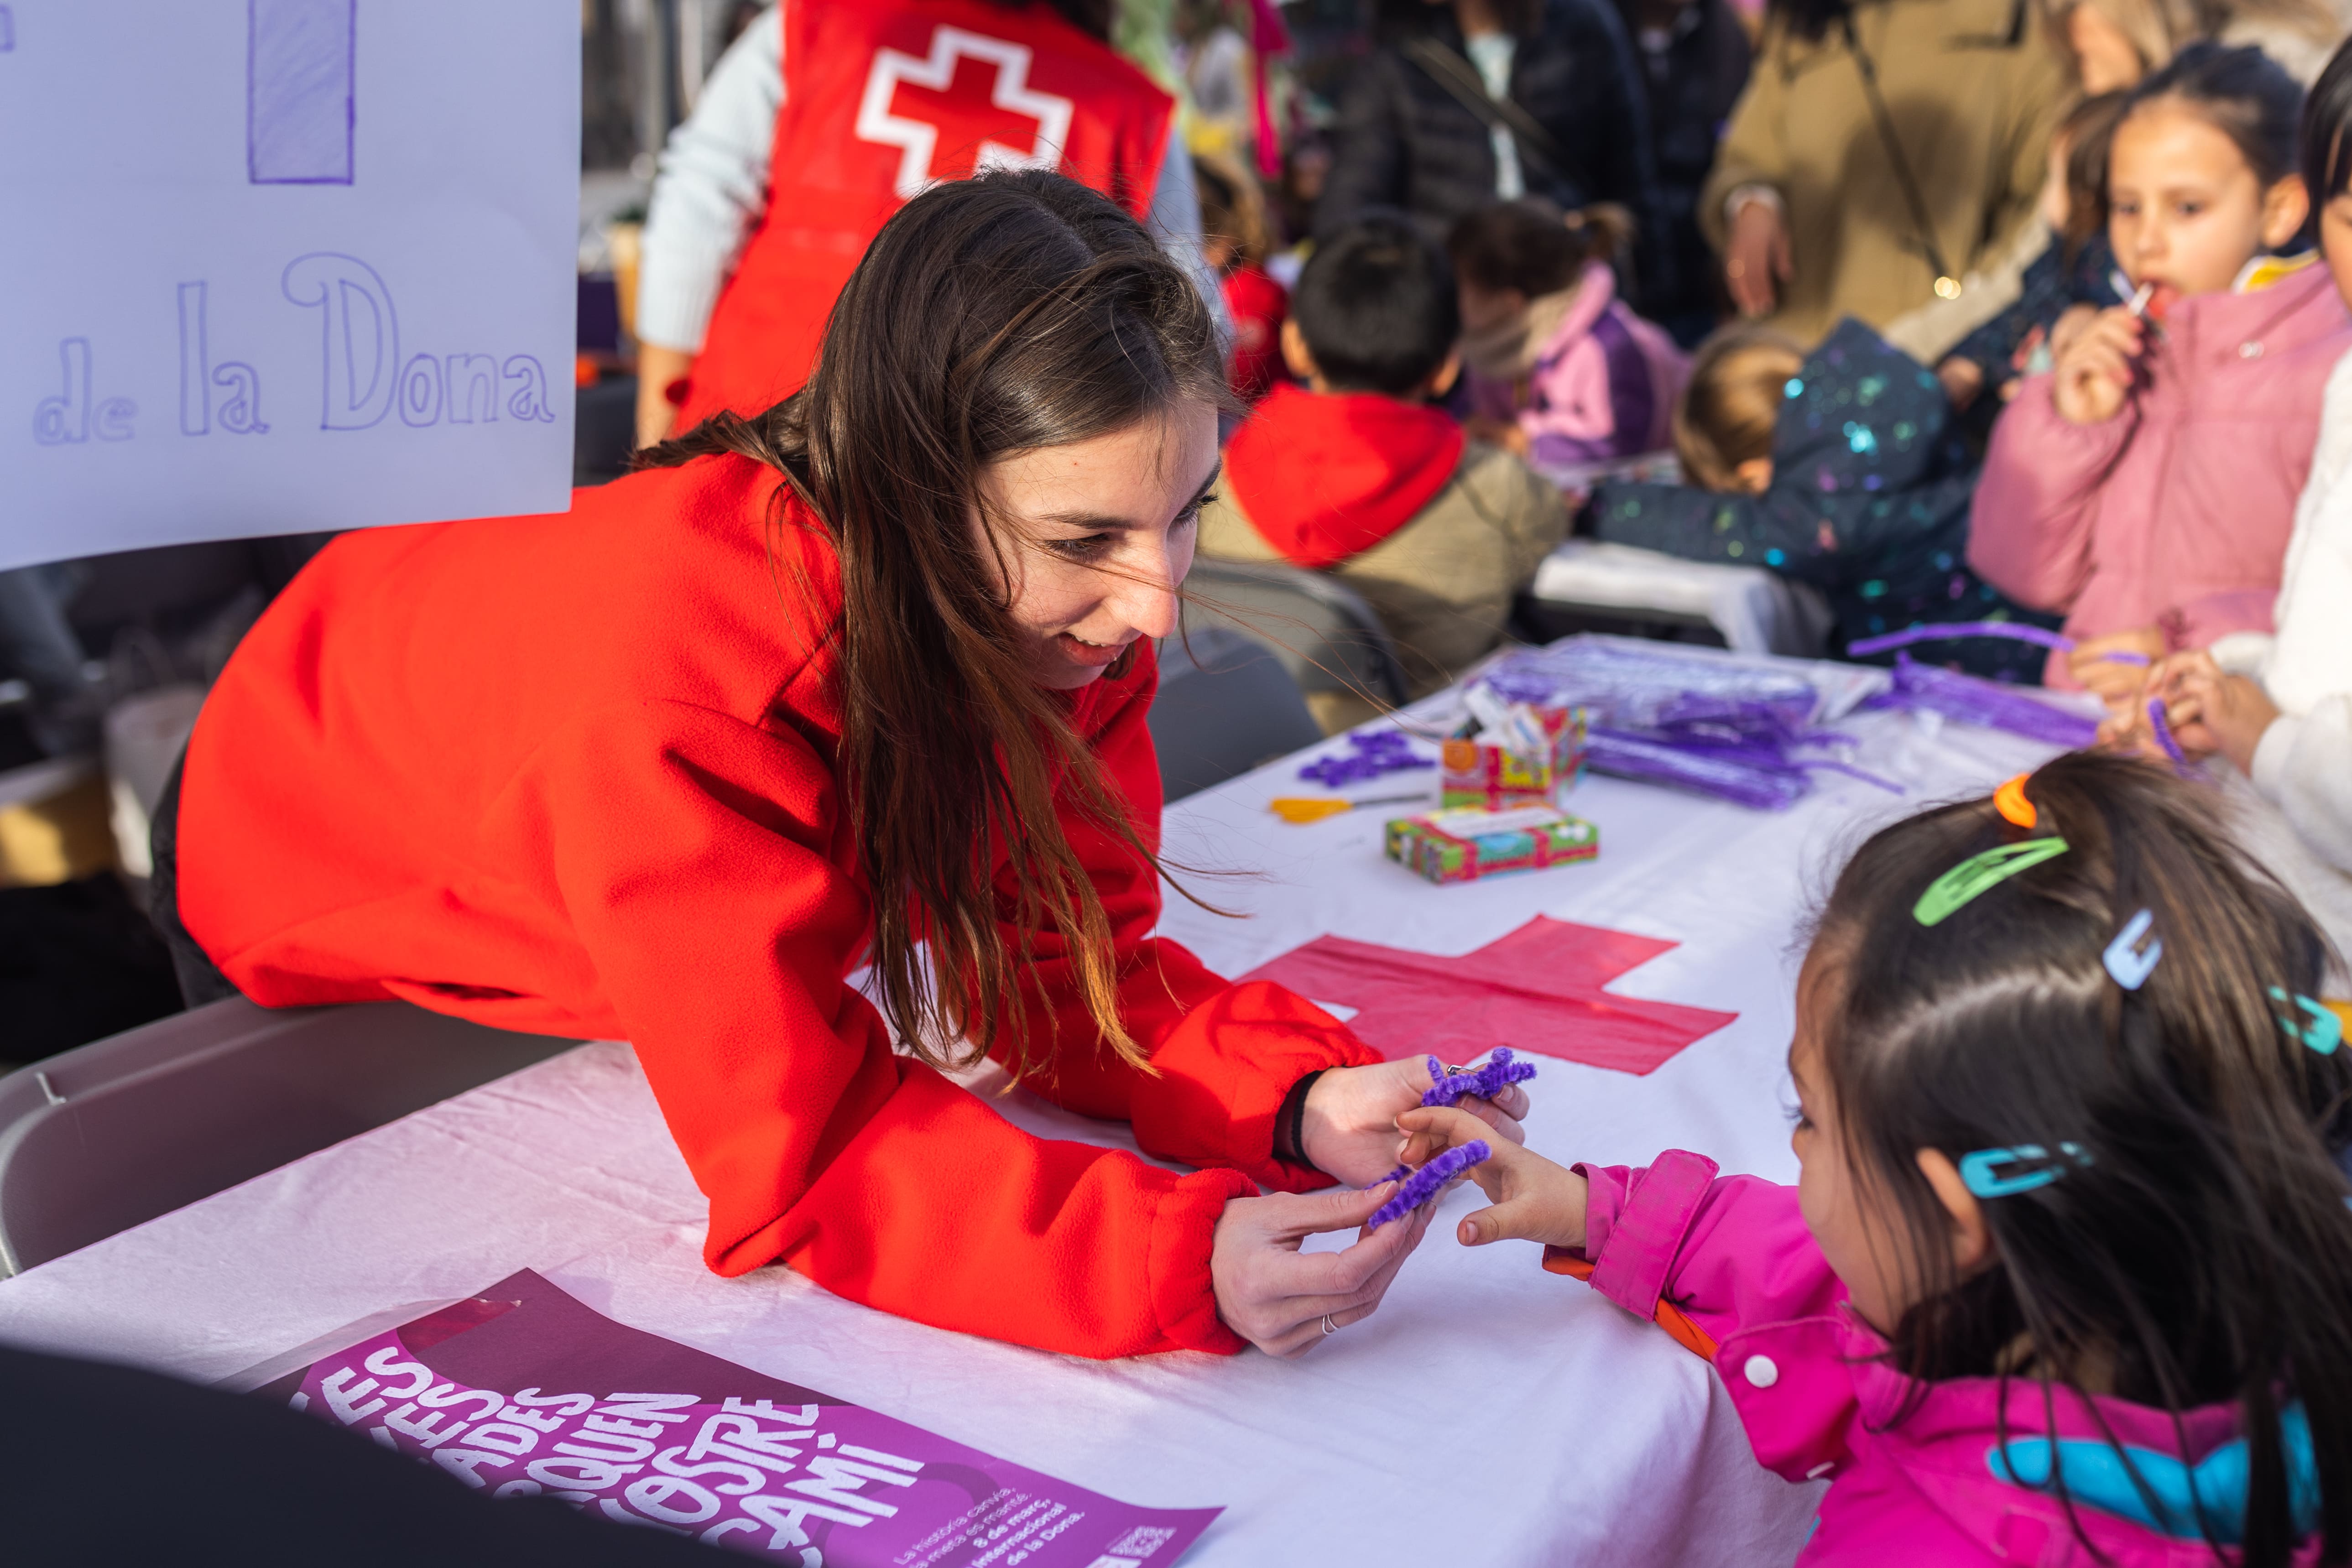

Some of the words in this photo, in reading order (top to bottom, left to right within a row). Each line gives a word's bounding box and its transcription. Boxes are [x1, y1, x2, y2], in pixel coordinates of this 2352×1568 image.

[33, 337, 139, 447] de
[177, 280, 271, 437] la
[281, 251, 556, 432] Dona
[288, 1347, 433, 1426] ES
[417, 1388, 594, 1489] ADES
[927, 1534, 967, 1563] meta
[965, 1522, 985, 1536] es
[971, 1502, 1068, 1568] Internacional
[972, 1537, 989, 1548] 8
[987, 1523, 1009, 1540] de
[1007, 1498, 1051, 1526] març,
[1007, 1549, 1029, 1566] de
[1023, 1538, 1044, 1552] la
[1039, 1511, 1085, 1542] Dona.
[893, 1550, 917, 1565] La
